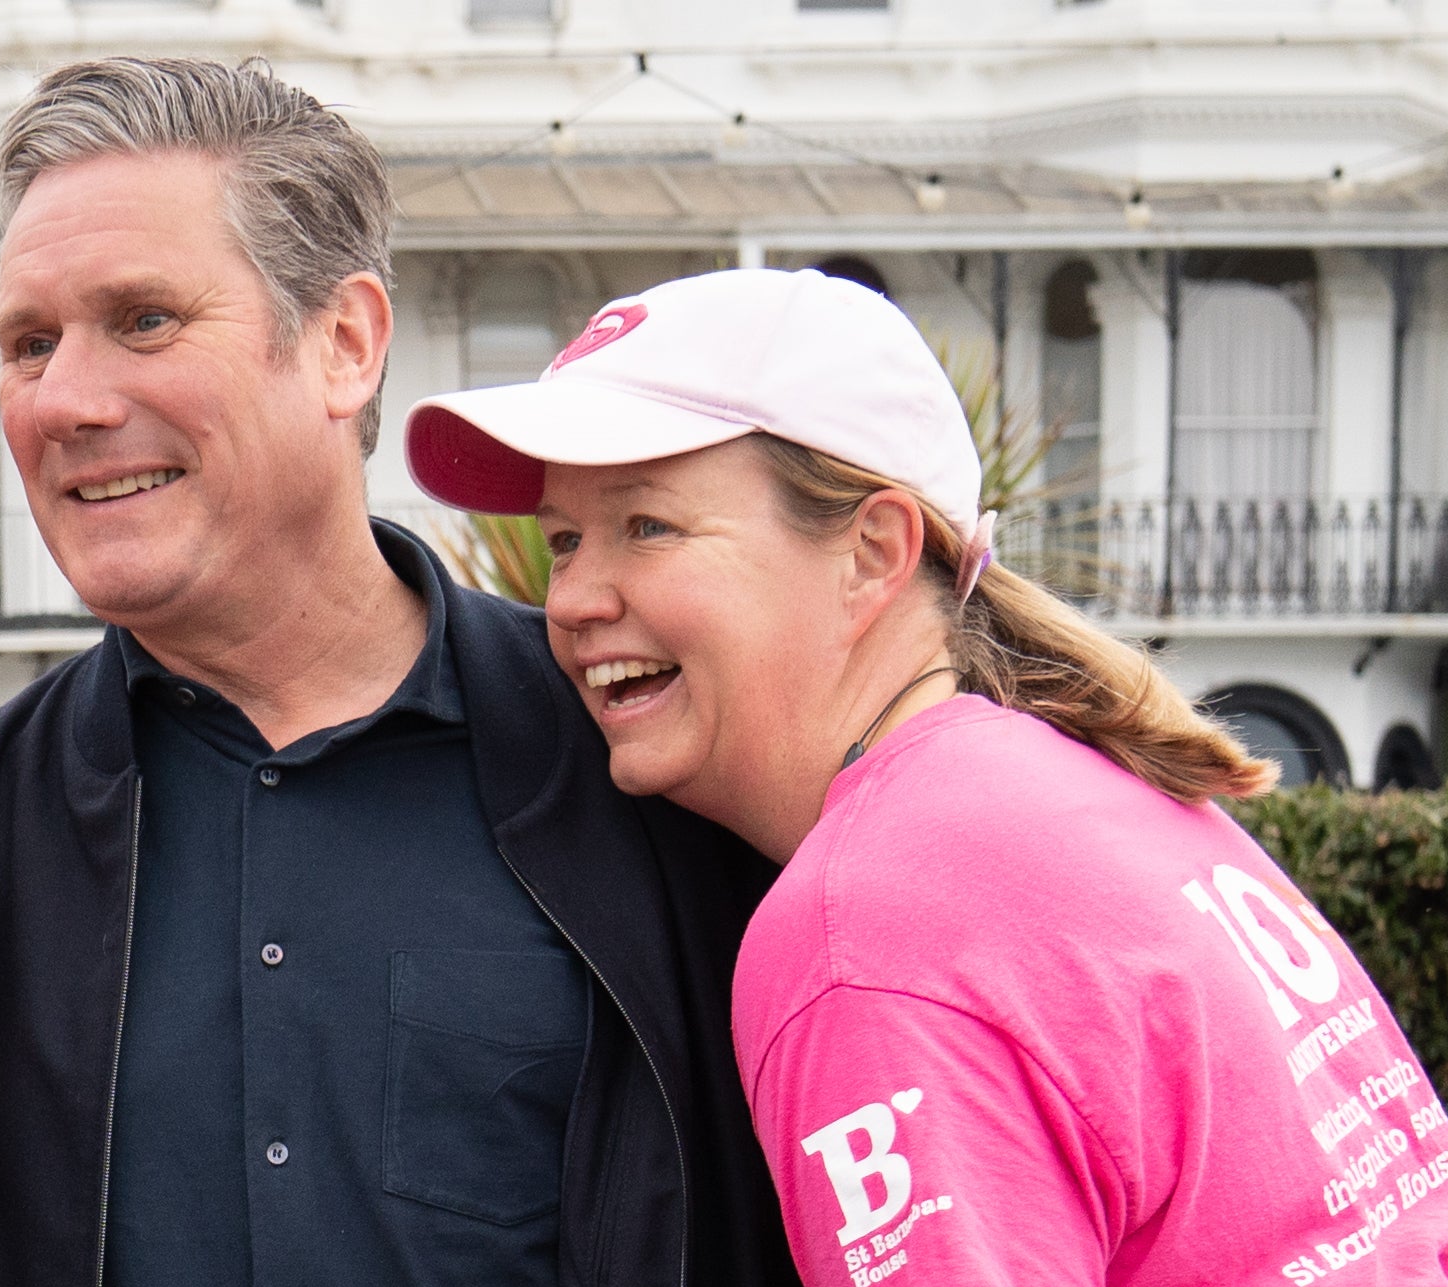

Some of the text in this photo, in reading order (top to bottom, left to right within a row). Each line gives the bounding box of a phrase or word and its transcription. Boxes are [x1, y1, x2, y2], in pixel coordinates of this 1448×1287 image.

[1180, 863, 1340, 1031] 10
[1286, 997, 1378, 1087] ANNIVERSAY
[800, 1102, 912, 1247] B
[844, 1245, 871, 1272] St
[1282, 1255, 1327, 1287] St
[1315, 1193, 1399, 1271] Barbas
